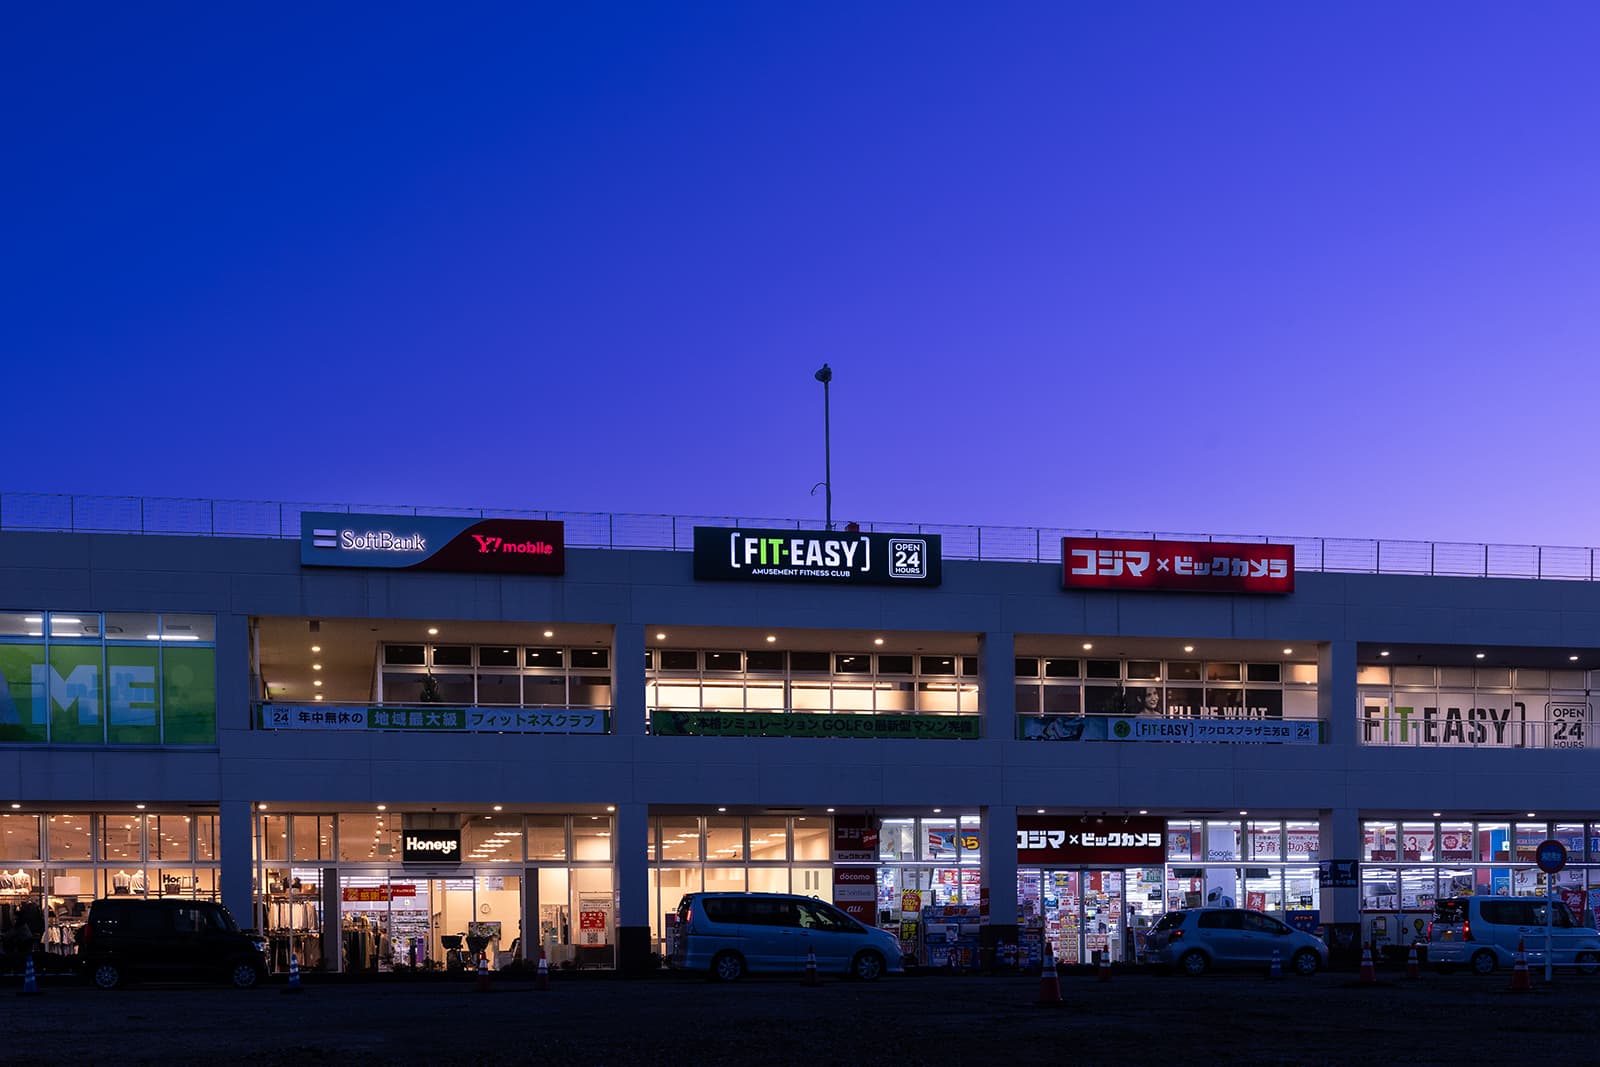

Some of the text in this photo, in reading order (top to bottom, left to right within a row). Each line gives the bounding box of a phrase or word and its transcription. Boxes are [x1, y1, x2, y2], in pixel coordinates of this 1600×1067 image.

[340, 530, 426, 551] SoftBank
[895, 543, 920, 552] OPEN
[895, 551, 920, 567] 24
[752, 568, 798, 576] AMUSEMENT
[799, 569, 829, 577] FITNESS
[895, 566, 920, 574] HOURS
[273, 712, 289, 722] 24
[1553, 708, 1585, 718] OPEN
[298, 711, 363, 724] 年中無休の
[471, 712, 596, 728] フィットネスクラブ
[1198, 726, 1290, 737] アクロスプラザ三芳店
[1297, 727, 1310, 737] 24
[1553, 719, 1585, 740] 24
[1553, 741, 1585, 749] HOURS
[406, 837, 457, 853] Honeys
[1207, 849, 1233, 858] Google
[839, 872, 871, 880] docomo
[846, 905, 864, 913] au
